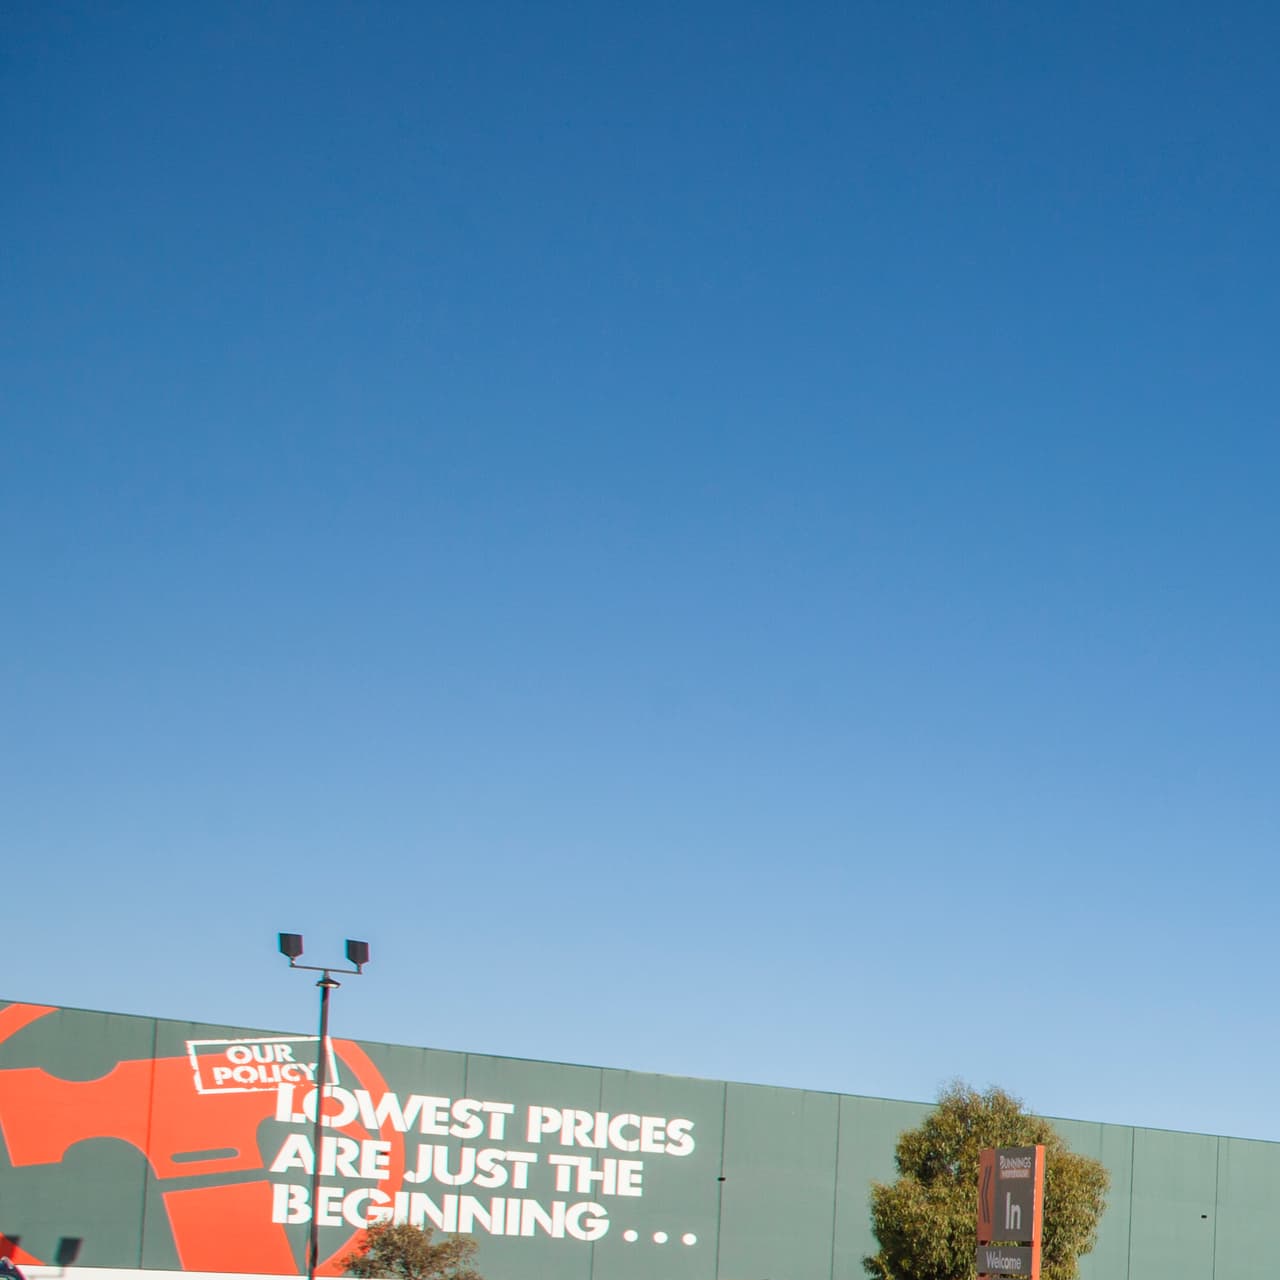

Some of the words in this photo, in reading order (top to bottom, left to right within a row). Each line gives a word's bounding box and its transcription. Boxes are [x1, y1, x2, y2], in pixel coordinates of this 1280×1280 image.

[212, 1062, 318, 1085] POLICY
[225, 1044, 295, 1065] OUR
[274, 1082, 515, 1141] LOWEST
[526, 1105, 696, 1157] PRICES
[269, 1133, 392, 1180] ARE
[402, 1143, 538, 1190] JUST
[547, 1153, 644, 1197] THE
[271, 1183, 610, 1241] BEGINNING
[1005, 1191, 1021, 1230] In
[985, 1250, 1022, 1270] Welcome
